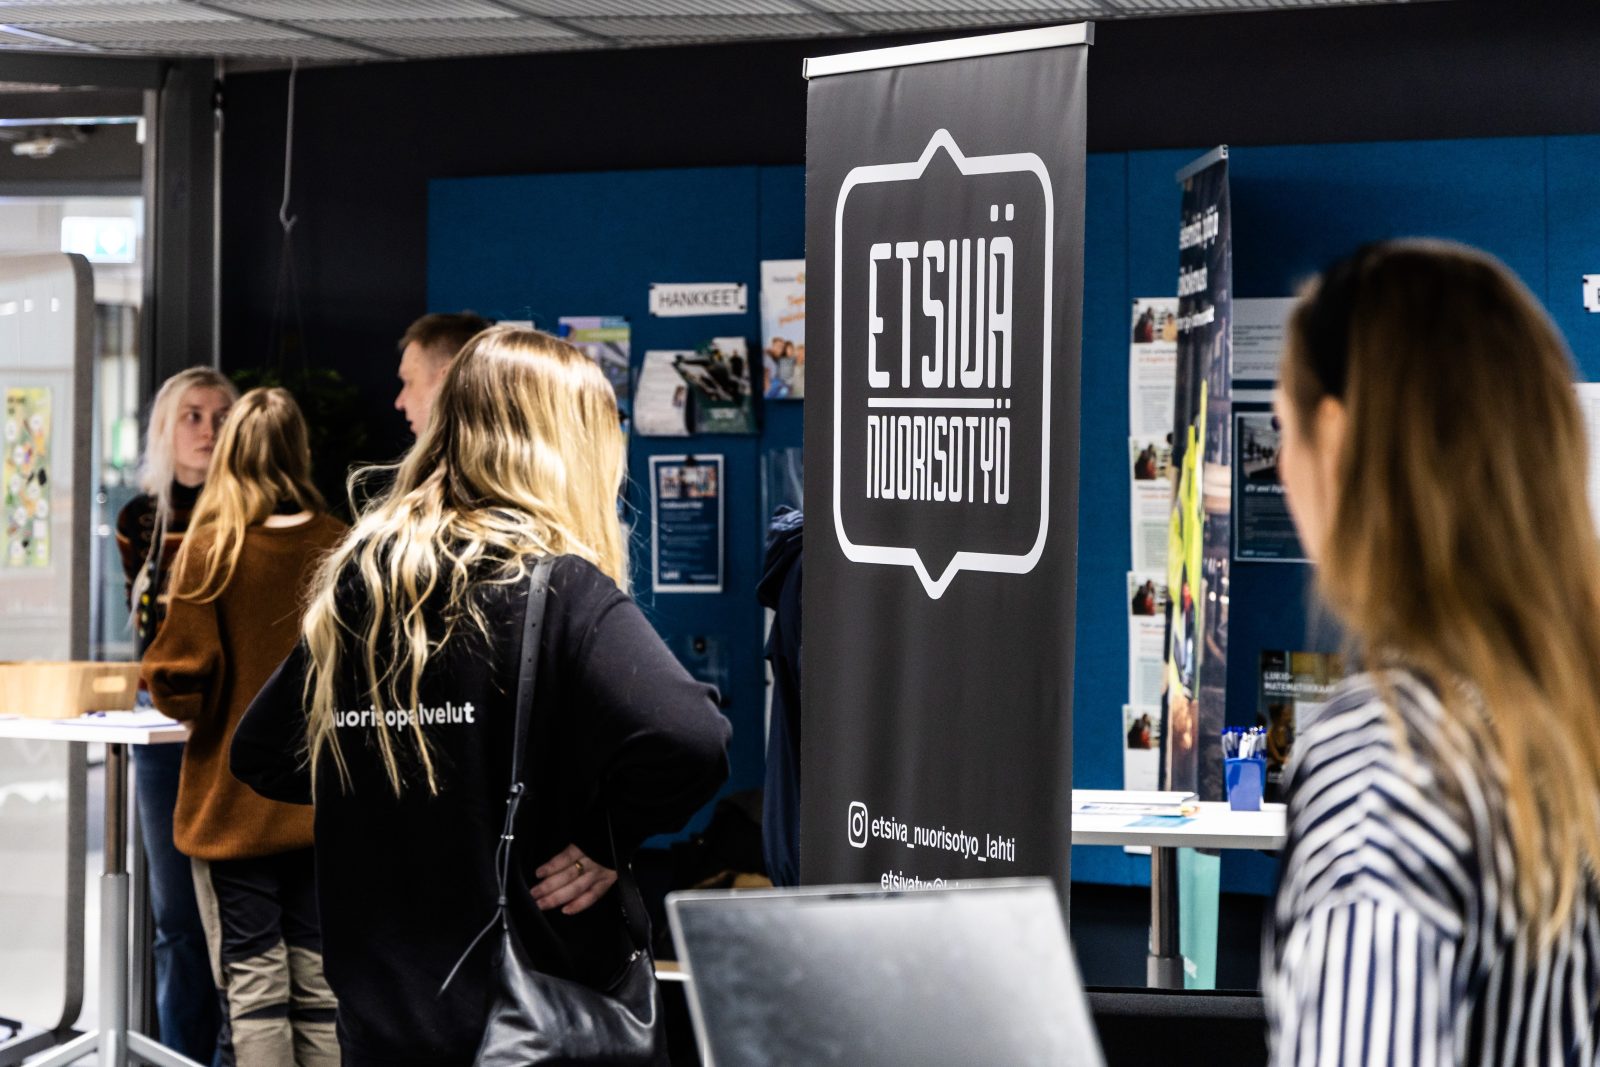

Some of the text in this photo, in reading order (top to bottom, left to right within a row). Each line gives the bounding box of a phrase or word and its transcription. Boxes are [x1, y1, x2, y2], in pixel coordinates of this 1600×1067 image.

[658, 288, 741, 308] HANKKEET
[866, 398, 1012, 505] NUORISOTYÖ
[332, 701, 475, 732] uorisopalvelut
[871, 816, 1016, 862] etsiva_nuorisotyo_lahti
